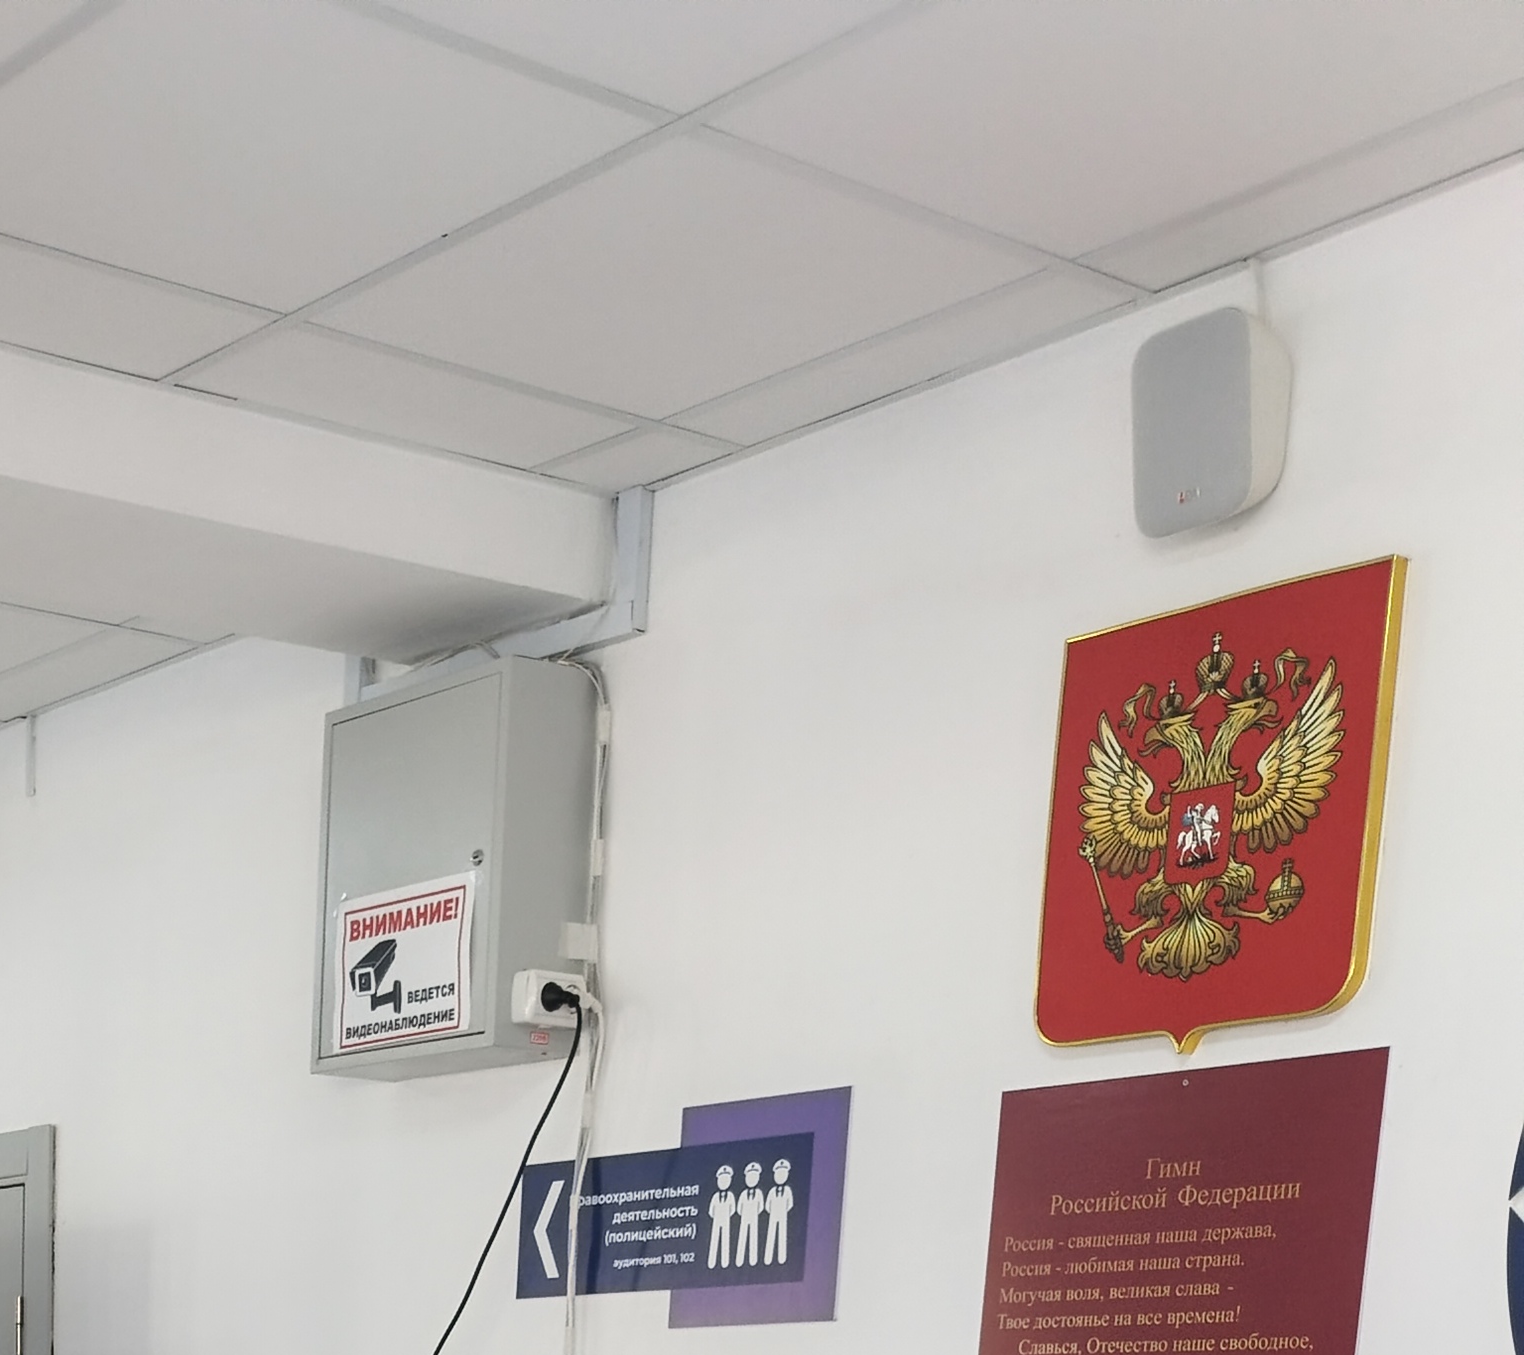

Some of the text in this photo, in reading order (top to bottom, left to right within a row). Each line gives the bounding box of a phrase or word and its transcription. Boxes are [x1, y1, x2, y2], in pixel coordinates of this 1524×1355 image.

[348, 896, 460, 942] ВНИМАНИЕ!
[407, 983, 455, 1004] ВЕДЕТСЯ
[345, 1008, 455, 1040] ВИДЕОНАБЛЮДЕНИЕ
[1144, 1156, 1201, 1180] Гимн
[578, 1185, 699, 1206] равоохранительная
[1049, 1181, 1300, 1216] Российской Федерации
[612, 1206, 698, 1224] деятельность
[605, 1223, 696, 1246] (полицейский)
[1003, 1223, 1276, 1252] Россия священная наша держава,
[613, 1255, 661, 1269] аудитория
[680, 1252, 695, 1263] 102
[1001, 1252, 1245, 1277] Россия любимая наша страна.
[998, 1281, 1220, 1307] Могучая воля, великая слава
[996, 1304, 1241, 1330] Твое достоянье на все времена!
[1085, 1336, 1168, 1354] Отечество
[1171, 1337, 1216, 1352] наше
[1218, 1331, 1314, 1352] свободное,
